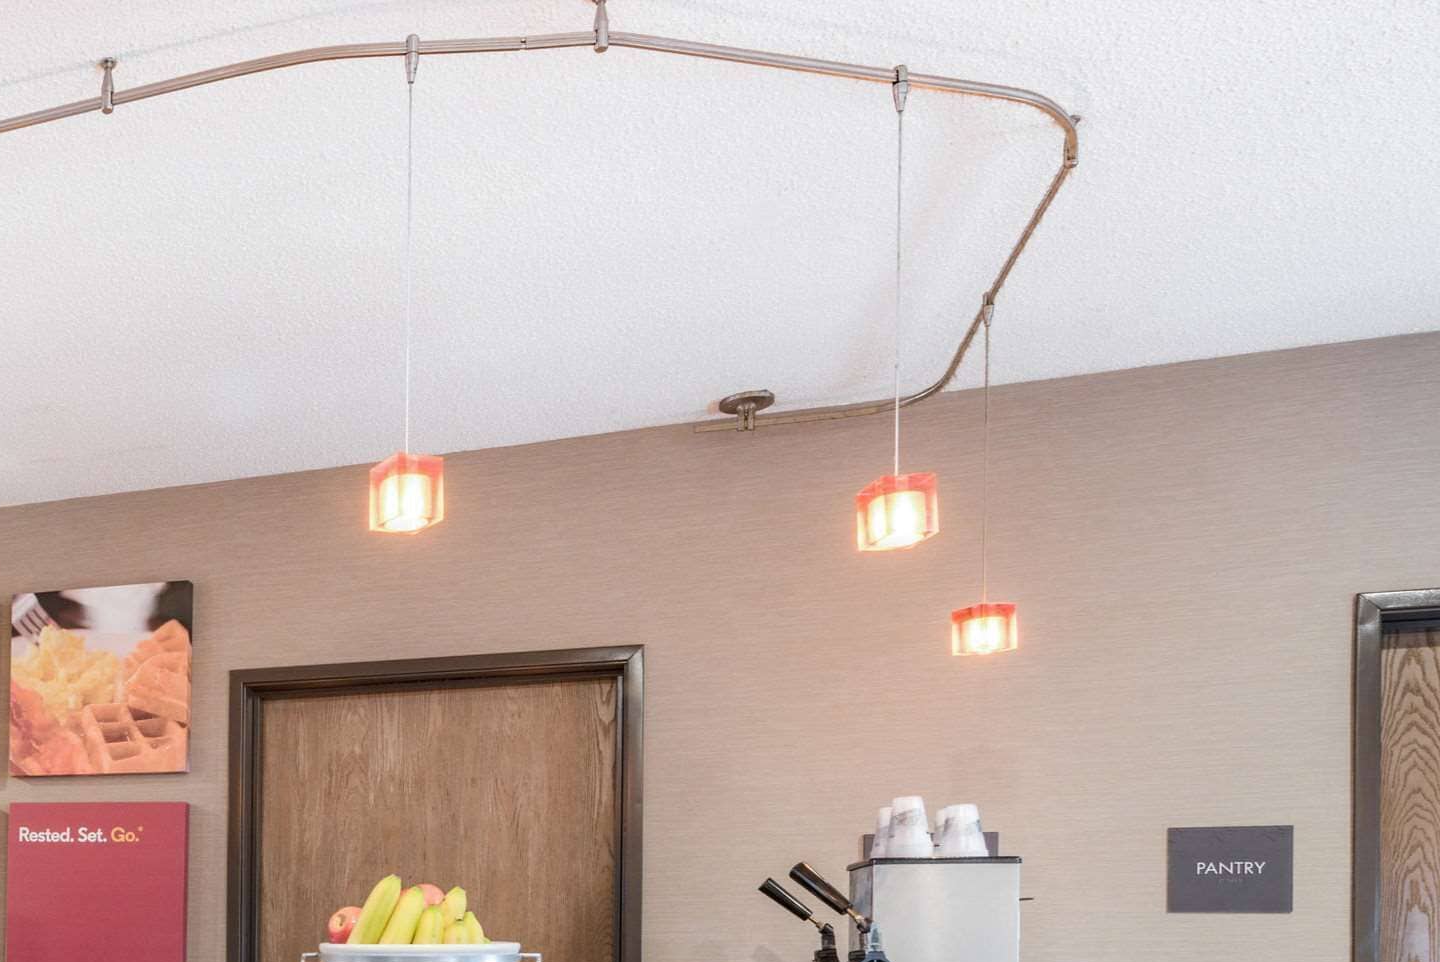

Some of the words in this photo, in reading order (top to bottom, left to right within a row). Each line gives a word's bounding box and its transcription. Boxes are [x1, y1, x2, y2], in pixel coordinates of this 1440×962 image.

[18, 827, 74, 842] Rested.
[77, 827, 107, 842] Set.
[1196, 861, 1266, 875] PANTRY
